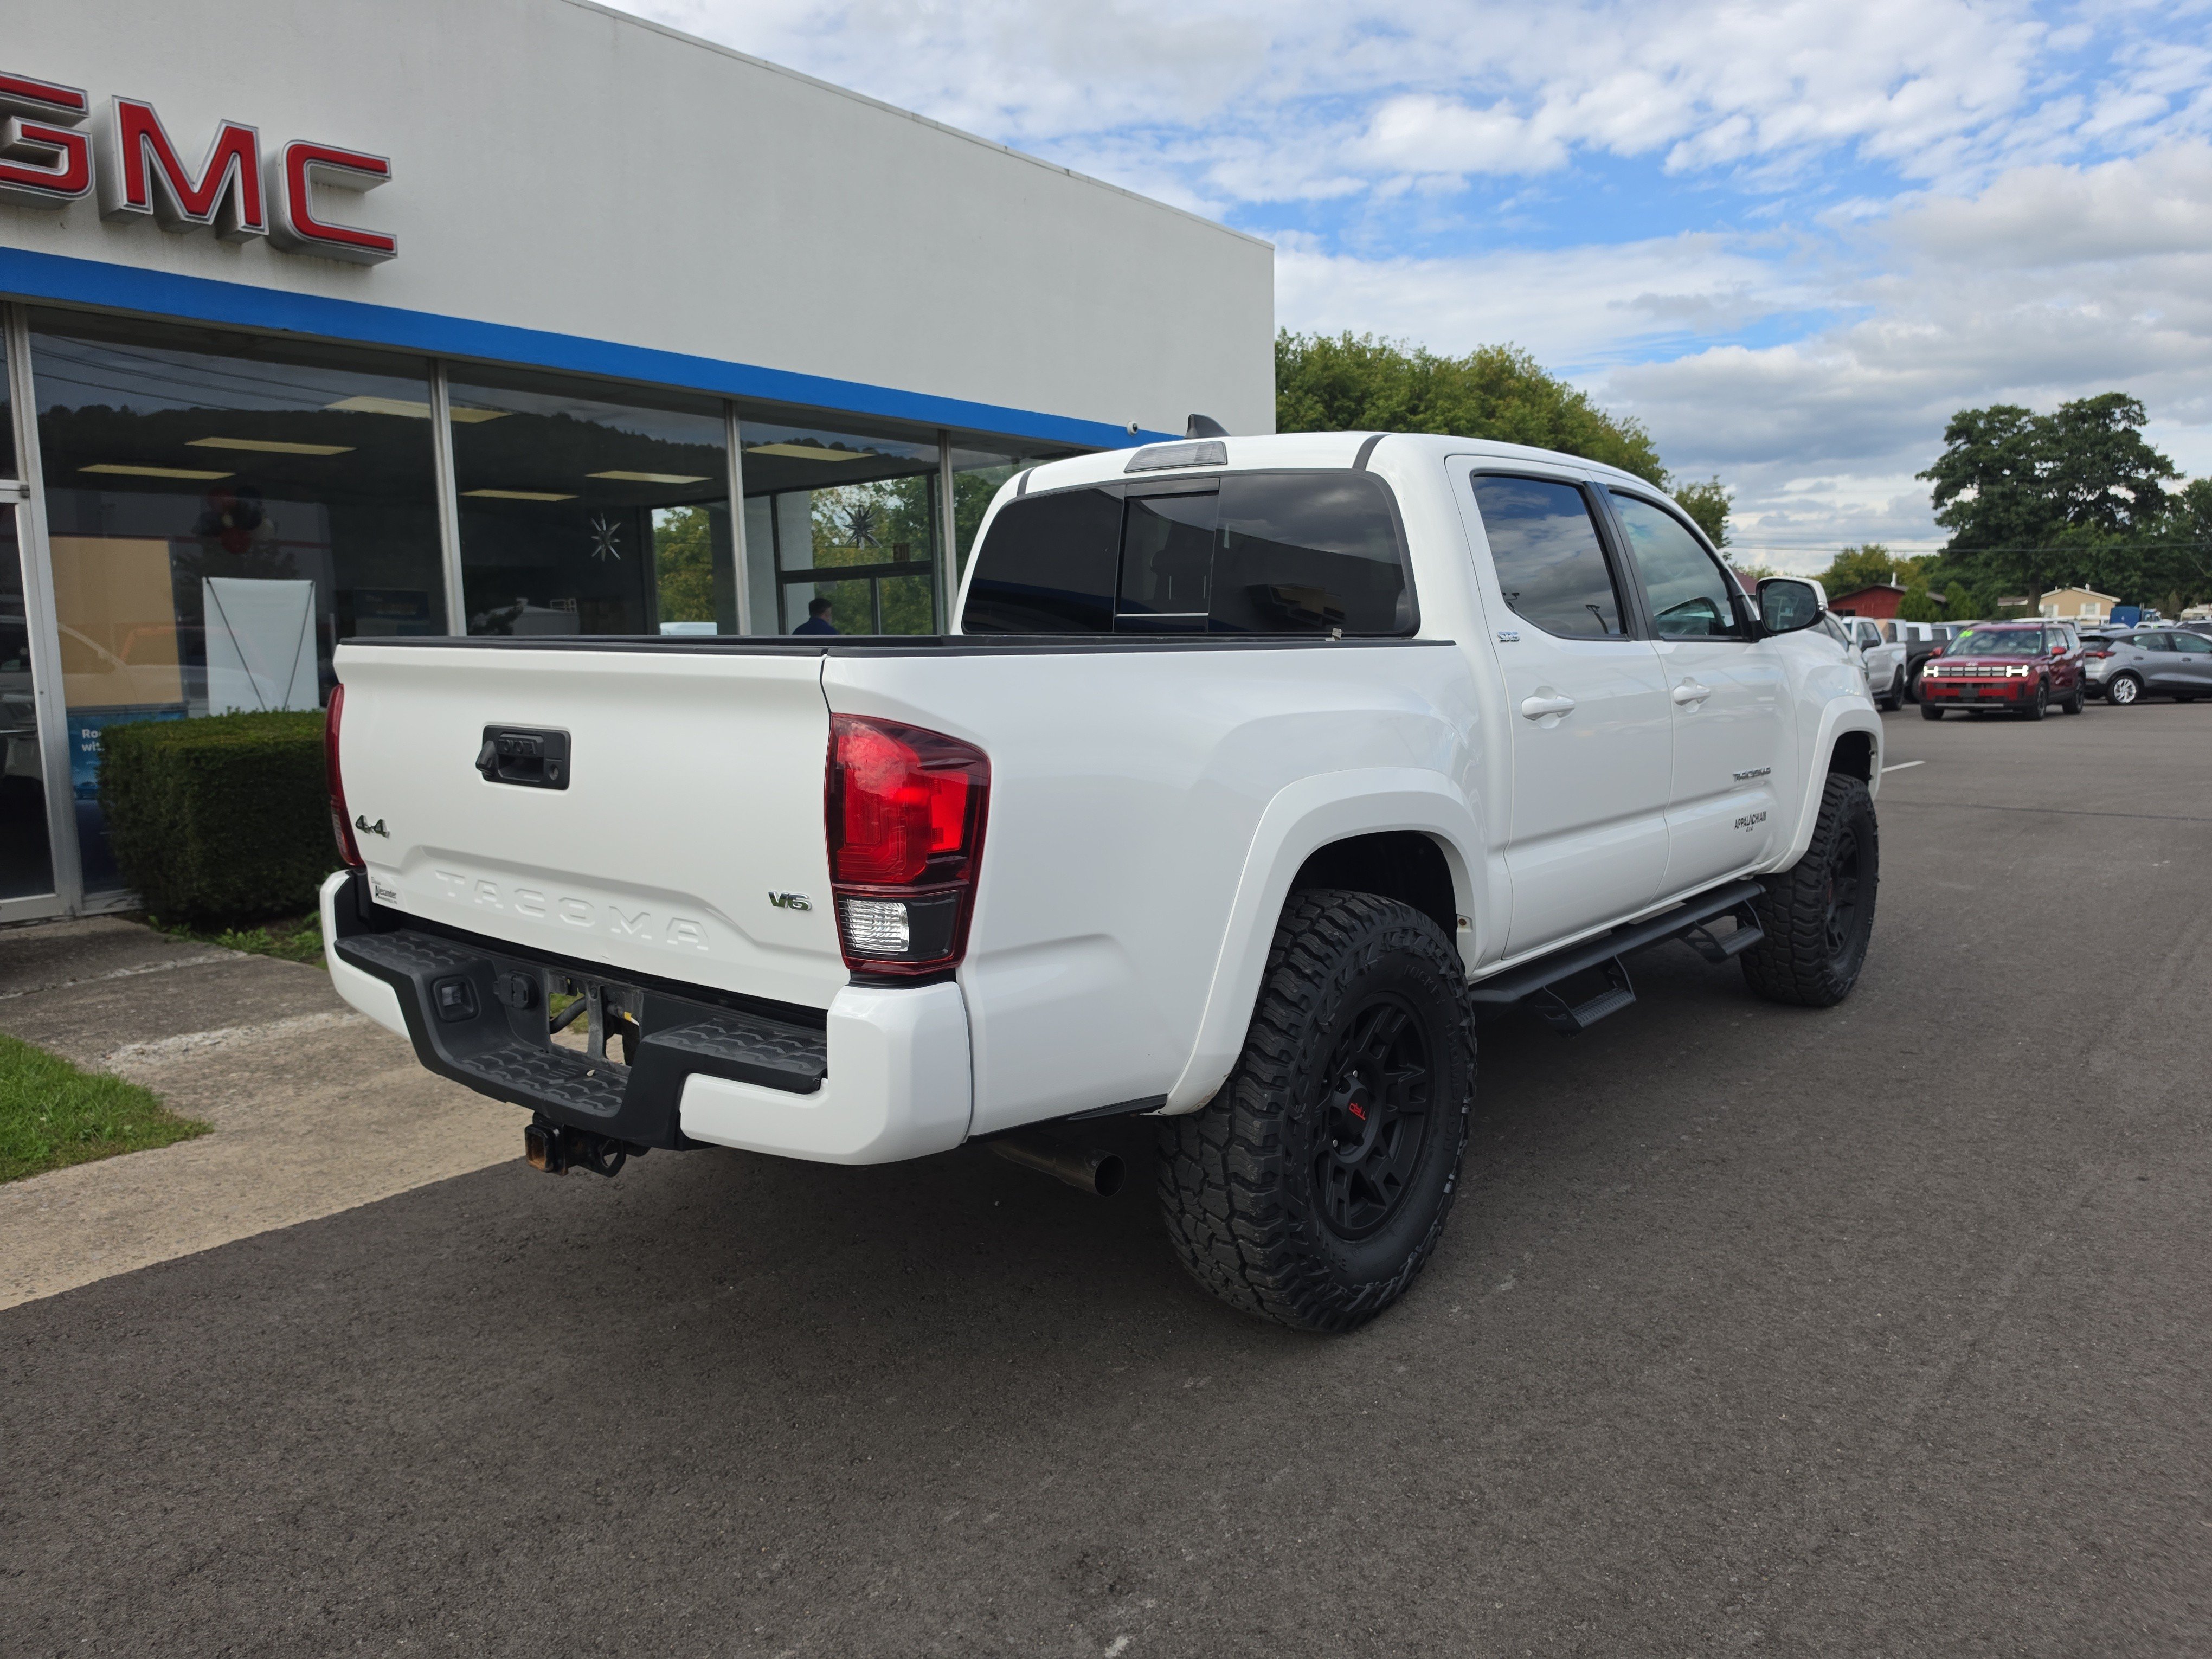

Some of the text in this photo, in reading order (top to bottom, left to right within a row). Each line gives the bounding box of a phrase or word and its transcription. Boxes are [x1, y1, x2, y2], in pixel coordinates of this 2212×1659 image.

[0, 70, 398, 262] GMC
[434, 870, 711, 951] TACOMA
[768, 890, 813, 911] V6
[1349, 1102, 1366, 1121] TRD
